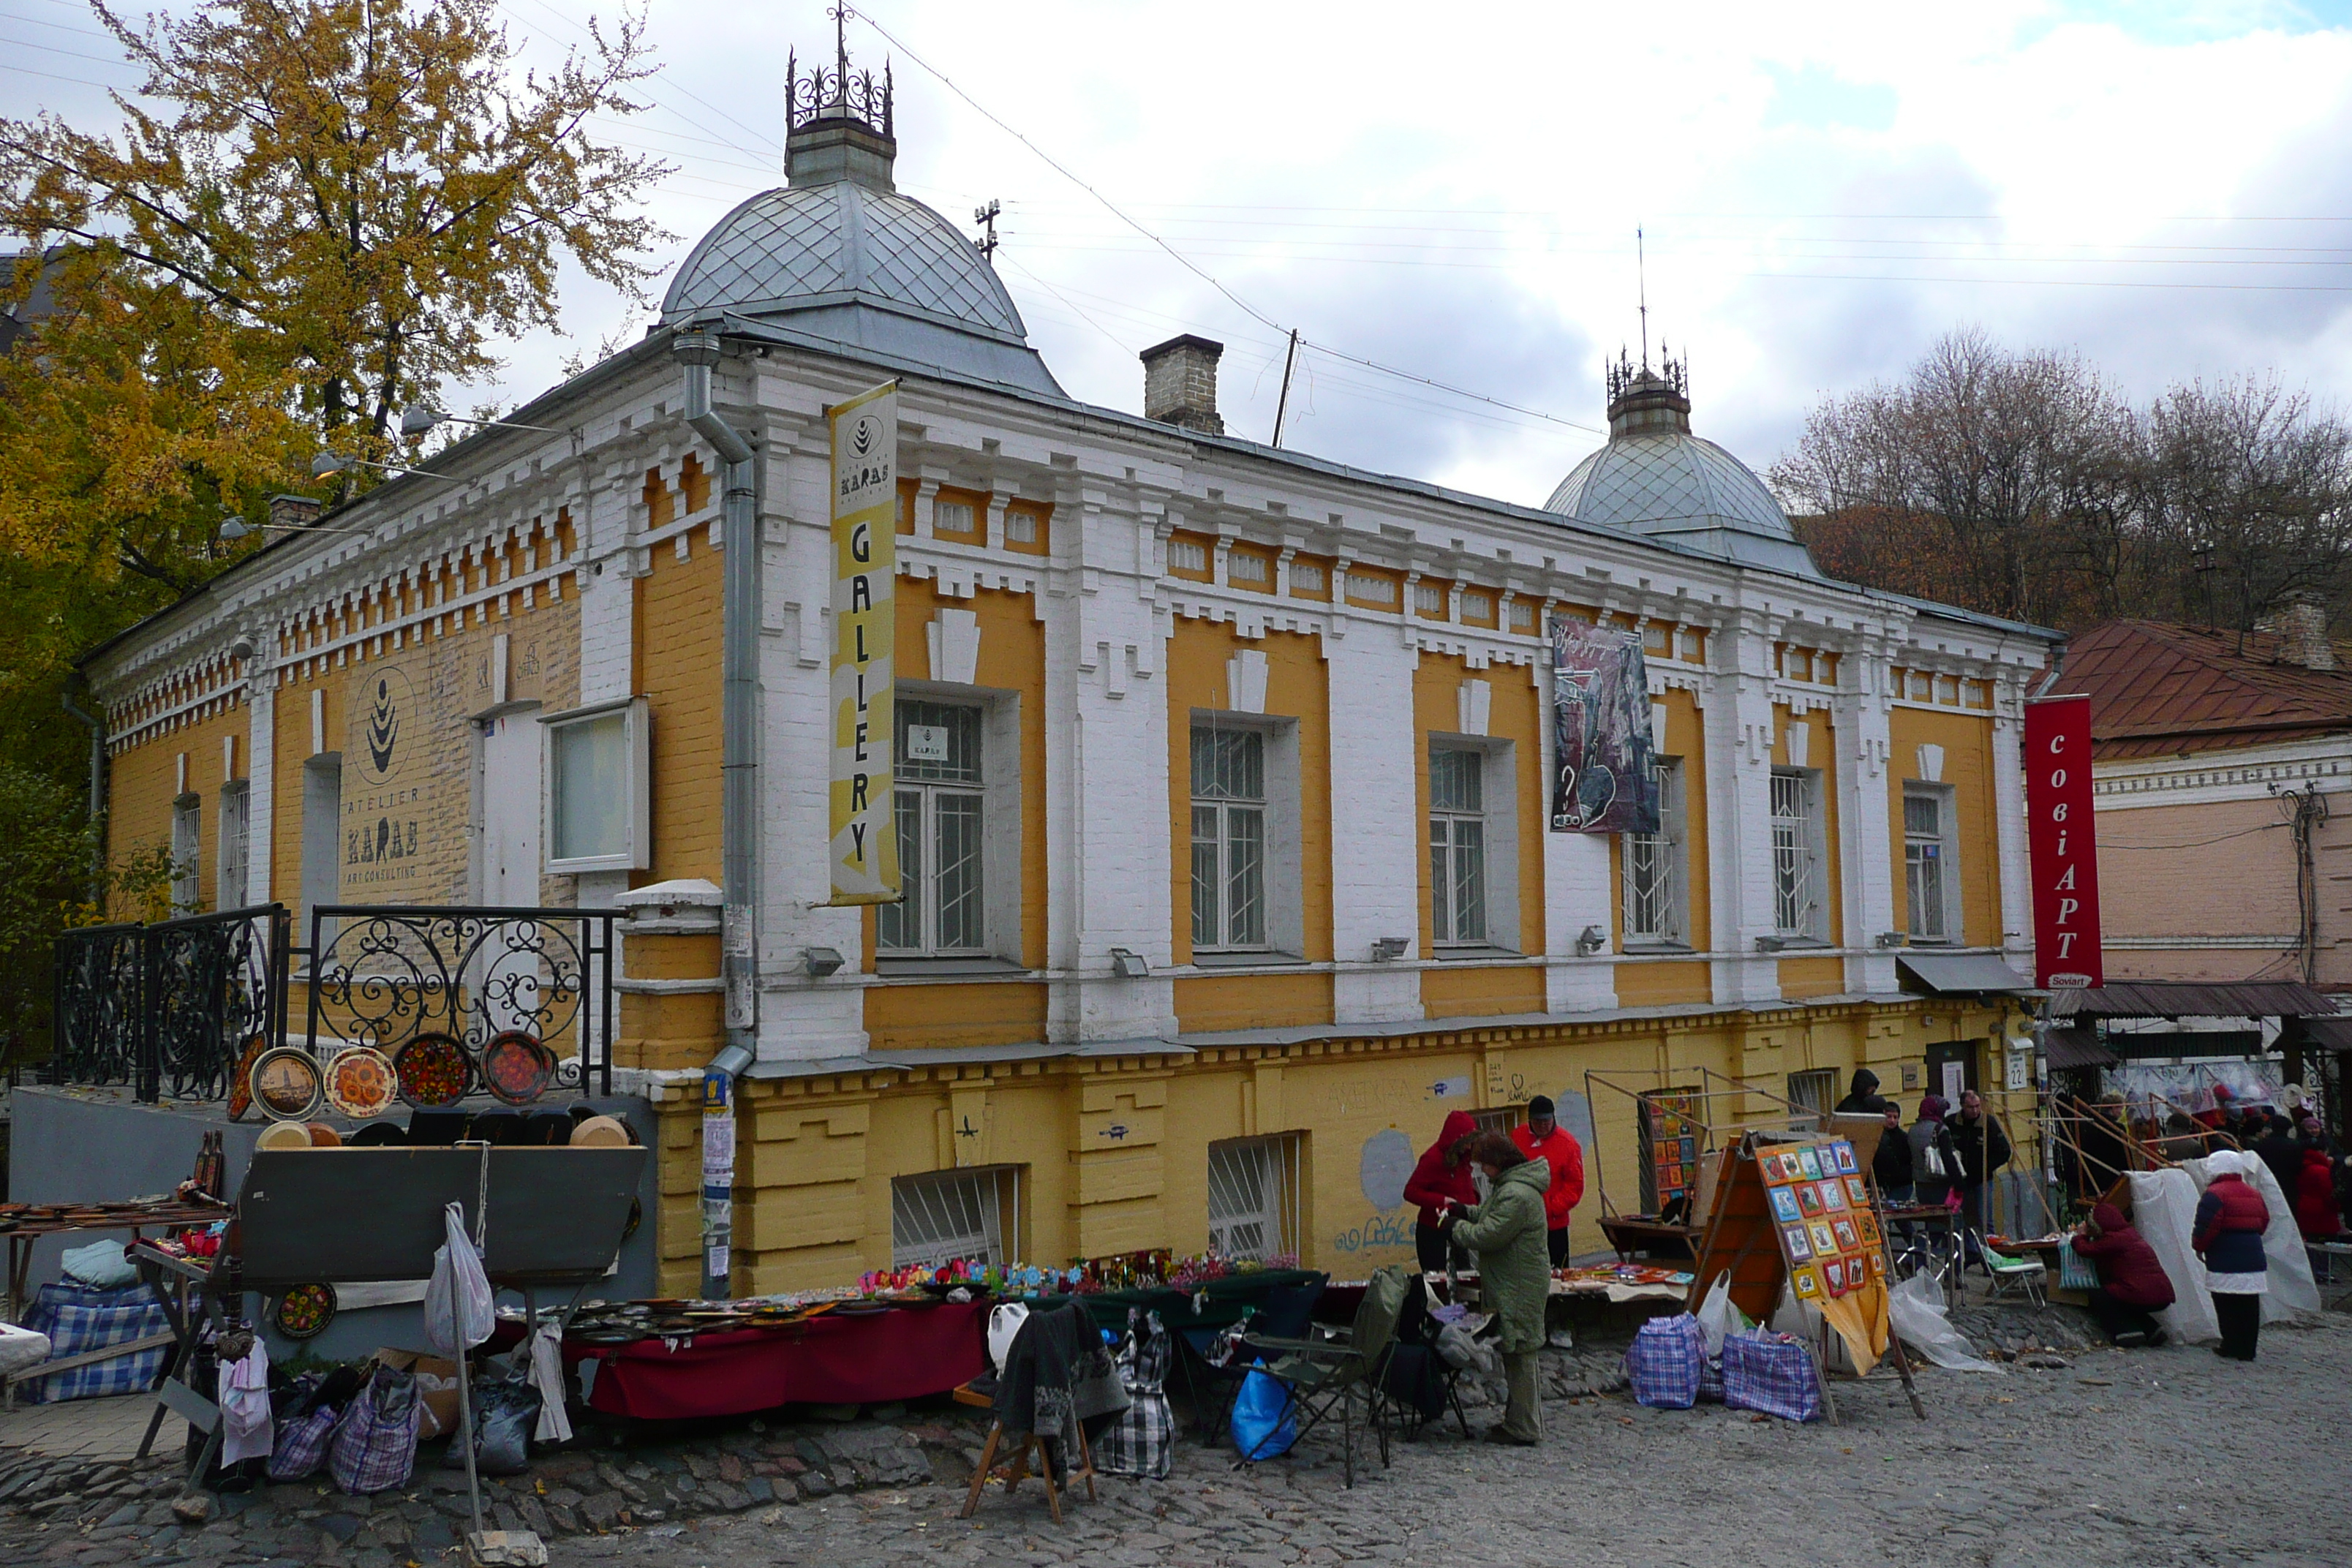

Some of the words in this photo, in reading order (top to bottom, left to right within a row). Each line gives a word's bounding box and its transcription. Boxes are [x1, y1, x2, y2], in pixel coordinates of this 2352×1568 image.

[840, 464, 889, 496] KARAS
[851, 523, 871, 863] GALLERY
[348, 788, 418, 814] ATELIER
[347, 817, 418, 866] KARAS
[347, 872, 363, 886] ART
[365, 865, 416, 883] CONSULTING
[2052, 976, 2084, 986] Soviart
